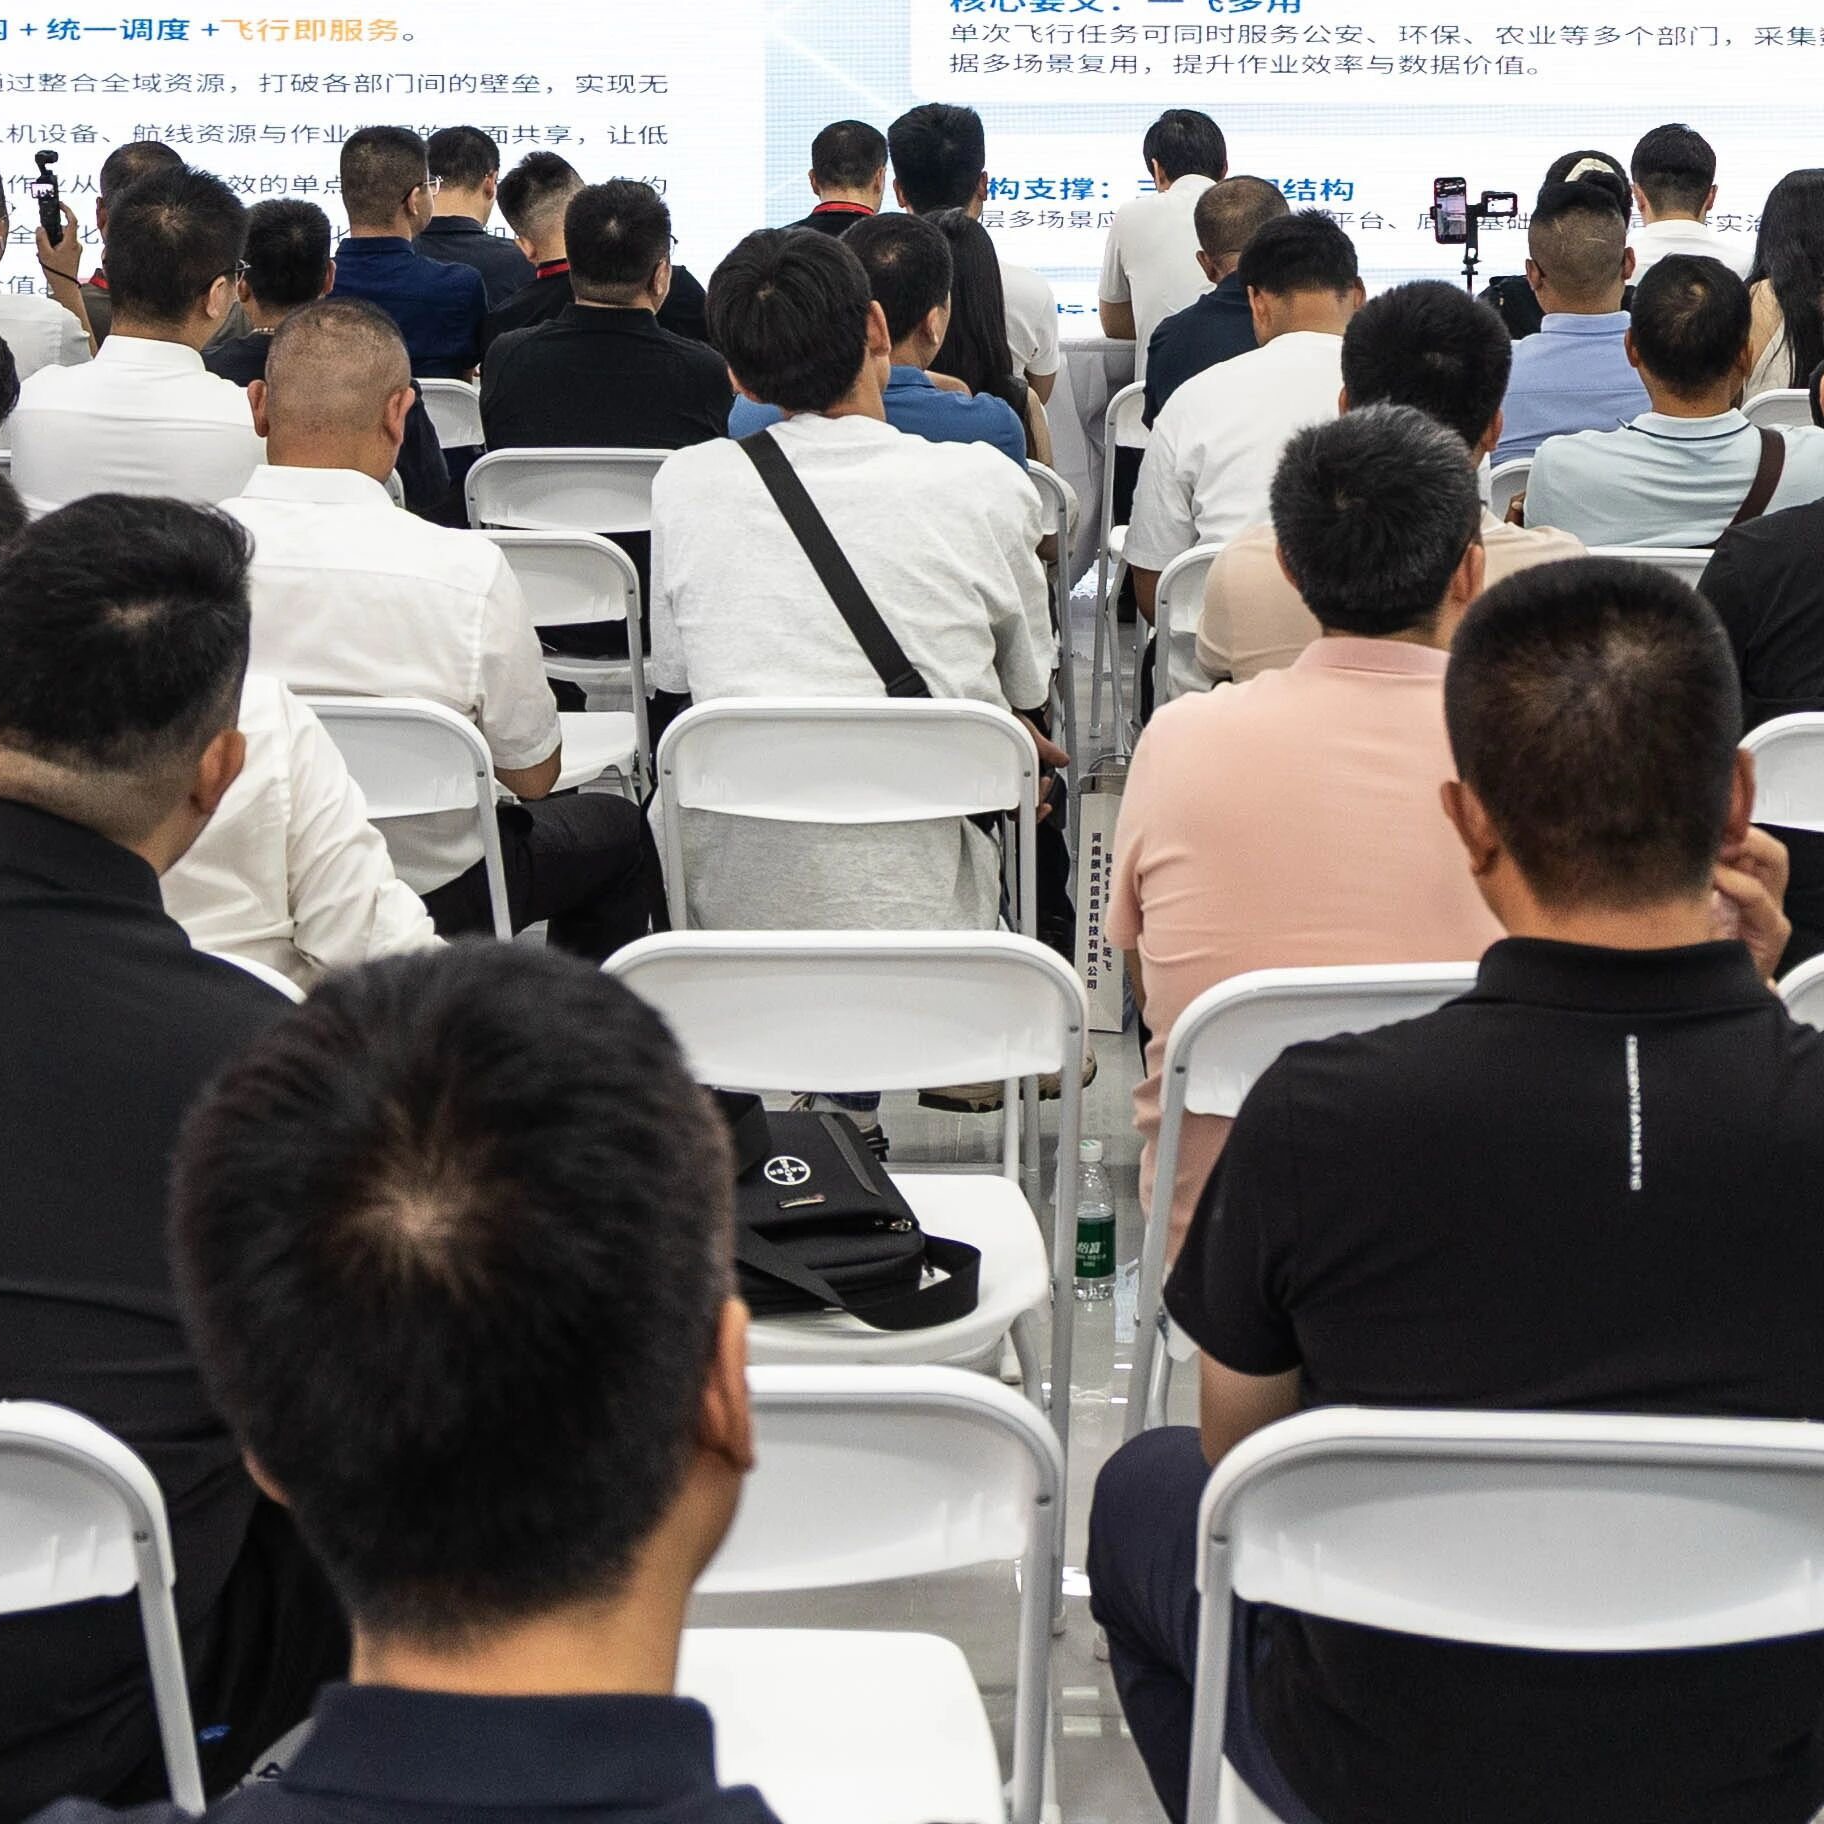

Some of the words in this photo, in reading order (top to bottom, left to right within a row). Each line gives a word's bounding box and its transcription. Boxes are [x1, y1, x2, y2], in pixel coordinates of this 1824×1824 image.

[46, 18, 190, 42] 统一调度
[951, 53, 1538, 75] 据多场景复用，提升作业效率与数据价值。
